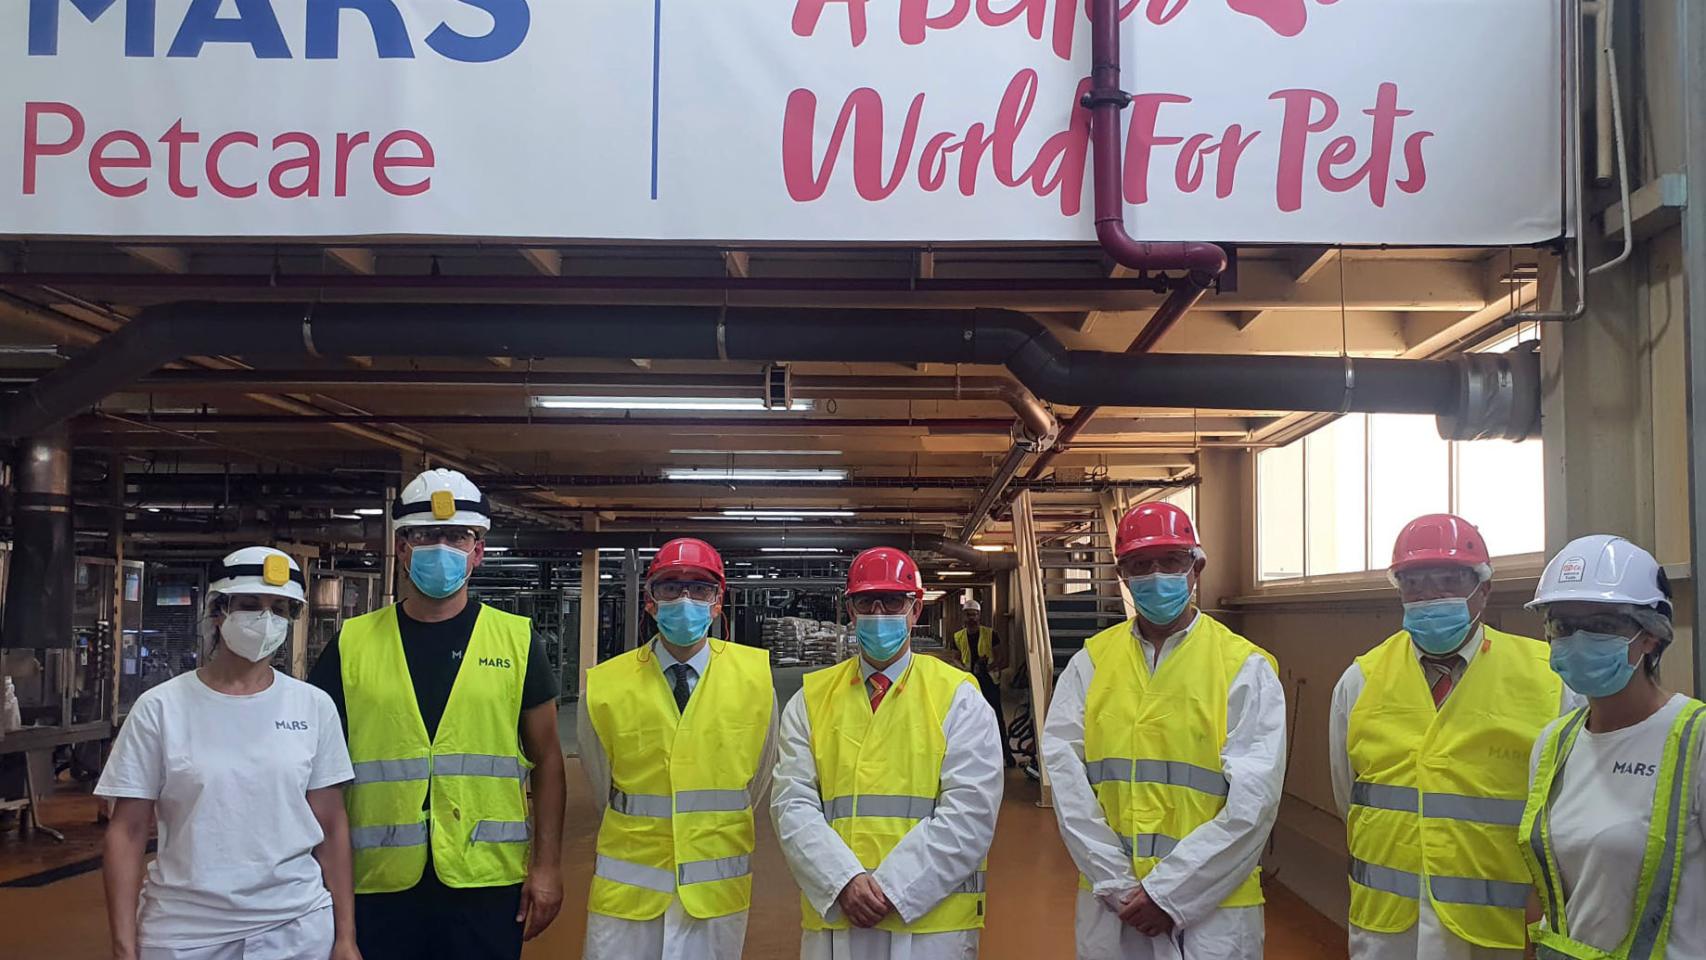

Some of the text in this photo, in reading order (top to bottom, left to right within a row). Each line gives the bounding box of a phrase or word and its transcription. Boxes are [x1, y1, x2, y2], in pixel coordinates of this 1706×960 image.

[28, 0, 531, 62] MARS
[22, 101, 435, 198] Petcare
[782, 68, 1435, 216] World For Pets
[478, 656, 511, 669] MARS
[275, 719, 308, 731] MARS
[1612, 760, 1657, 776] MARS
